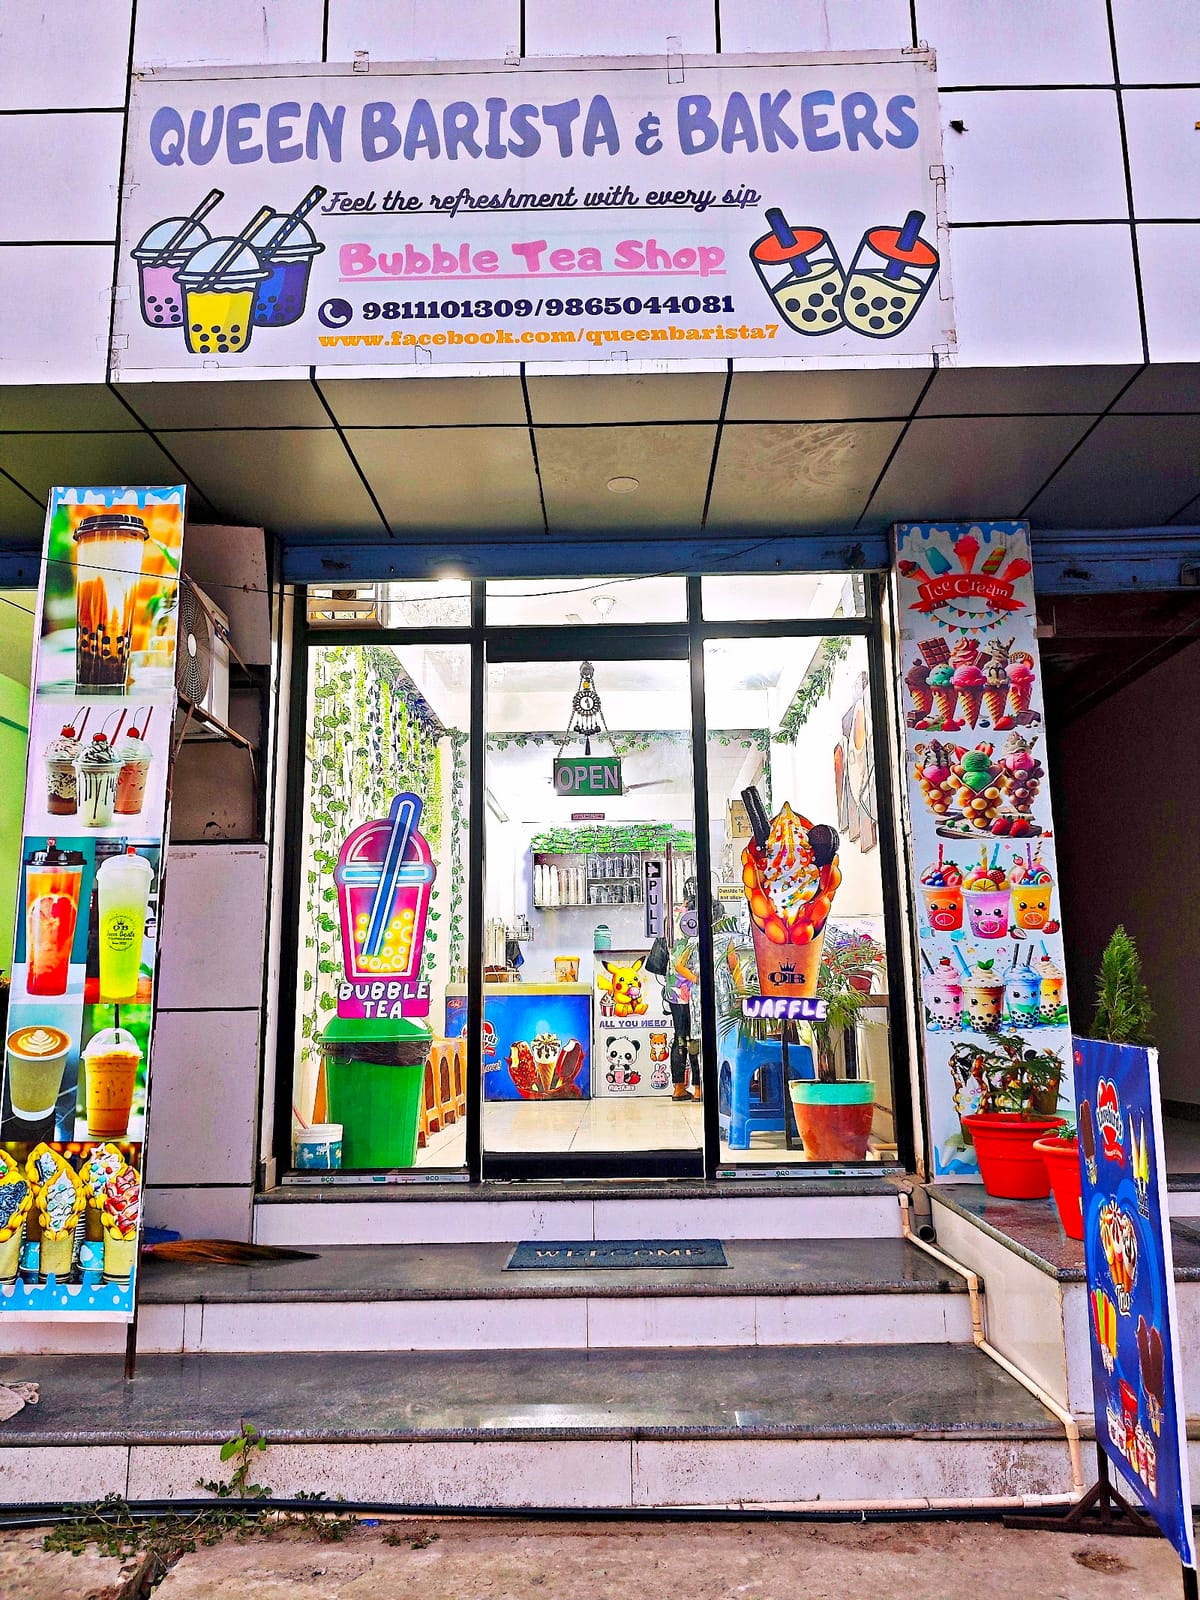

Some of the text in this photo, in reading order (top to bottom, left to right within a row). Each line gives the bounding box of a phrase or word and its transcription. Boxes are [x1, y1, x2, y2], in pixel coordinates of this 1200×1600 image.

[149, 89, 919, 166] QUEEN BARISTA & BAKERS
[321, 184, 761, 217] Feel the refreshment with every sip
[339, 239, 725, 277] Bubble Tea Shop
[363, 295, 735, 320] 9811101309/9865044081
[318, 323, 780, 348] www.facebook.com/queenbarista7
[925, 579, 1008, 600] Ice Cream
[557, 765, 619, 790] OPEN
[649, 881, 658, 934] PULL
[767, 972, 806, 986] QB
[339, 982, 429, 1000] BUBBLE
[363, 1000, 402, 1019] TEA
[742, 999, 829, 1019] WAFFLE
[600, 1020, 615, 1028] ALL
[535, 1248, 705, 1258] WELCOME
